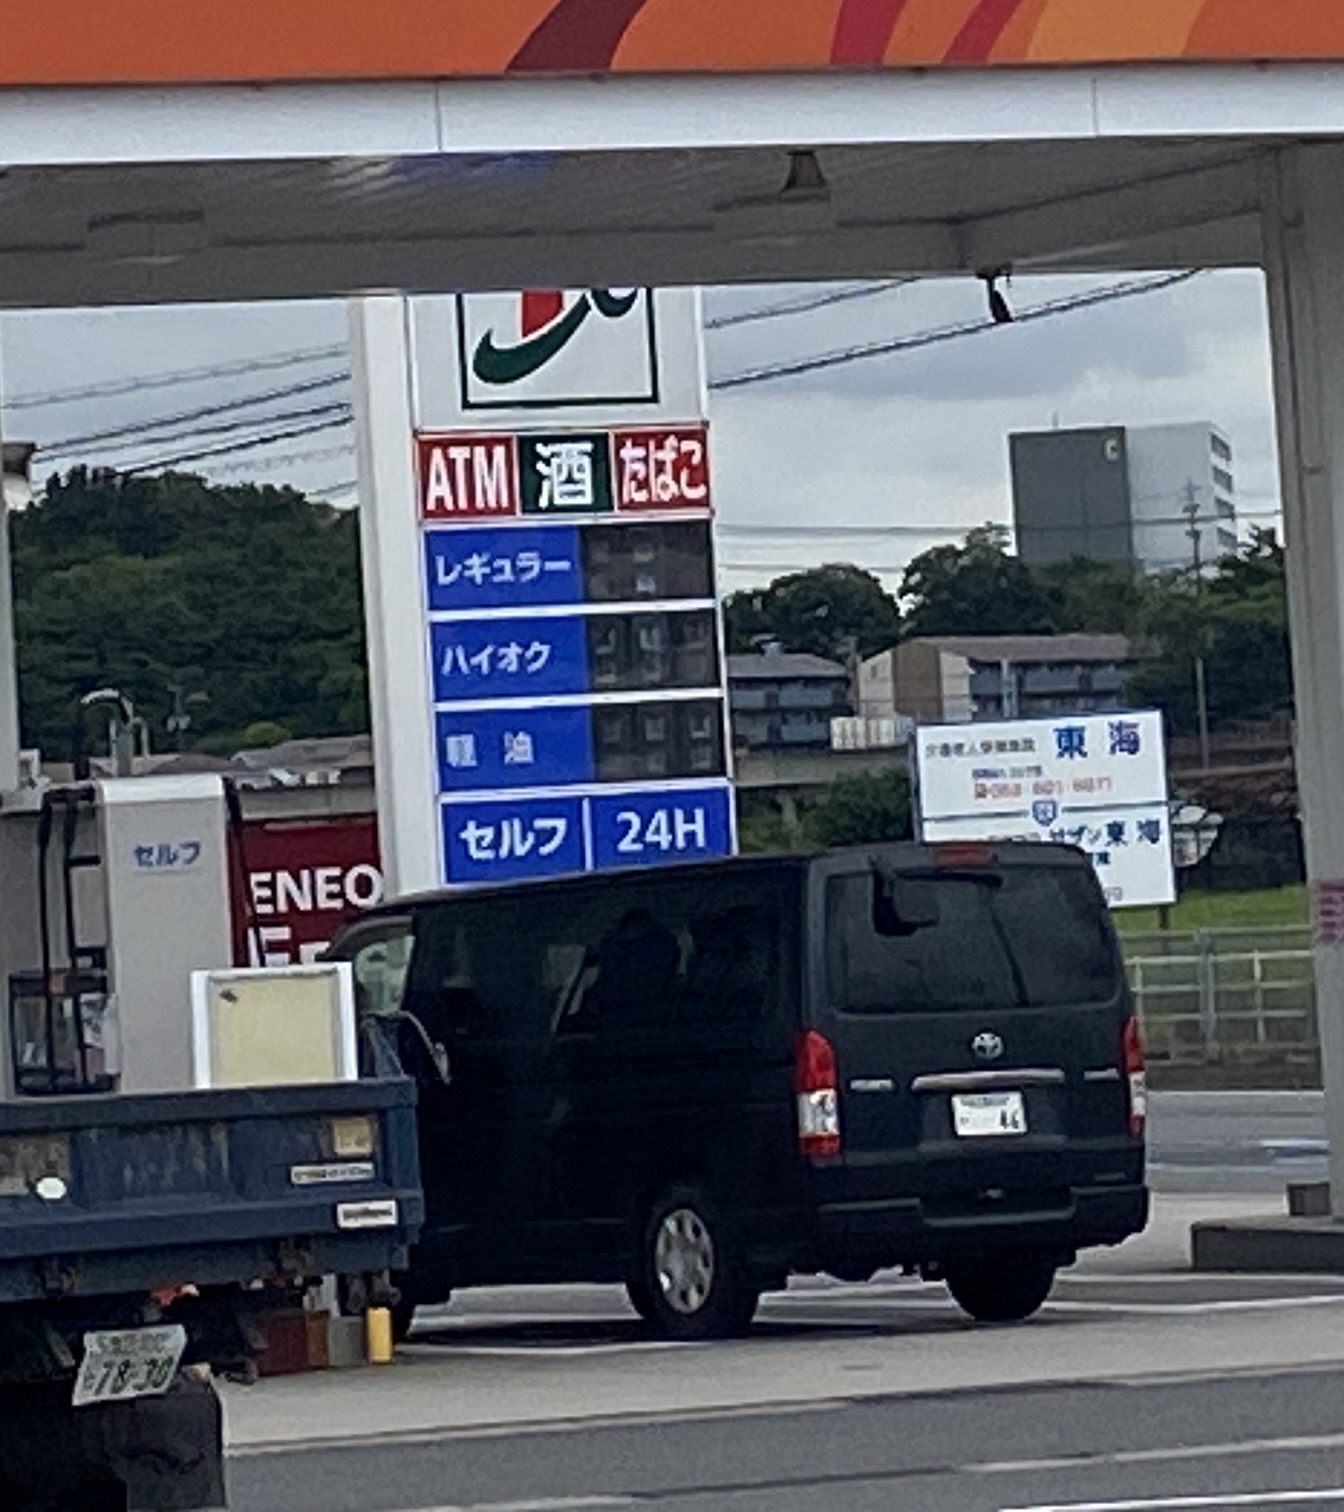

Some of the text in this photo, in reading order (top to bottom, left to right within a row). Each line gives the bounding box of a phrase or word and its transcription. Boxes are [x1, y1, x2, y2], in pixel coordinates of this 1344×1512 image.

[424, 445, 510, 511] ATM
[535, 441, 595, 510] 酒
[618, 435, 708, 502] たばこ
[434, 551, 573, 588] レギュラー
[441, 640, 552, 677] ハイオク
[1053, 720, 1141, 760] 東海
[459, 817, 568, 861] セルフ
[614, 809, 708, 854] 24H
[133, 840, 203, 869] セルフ
